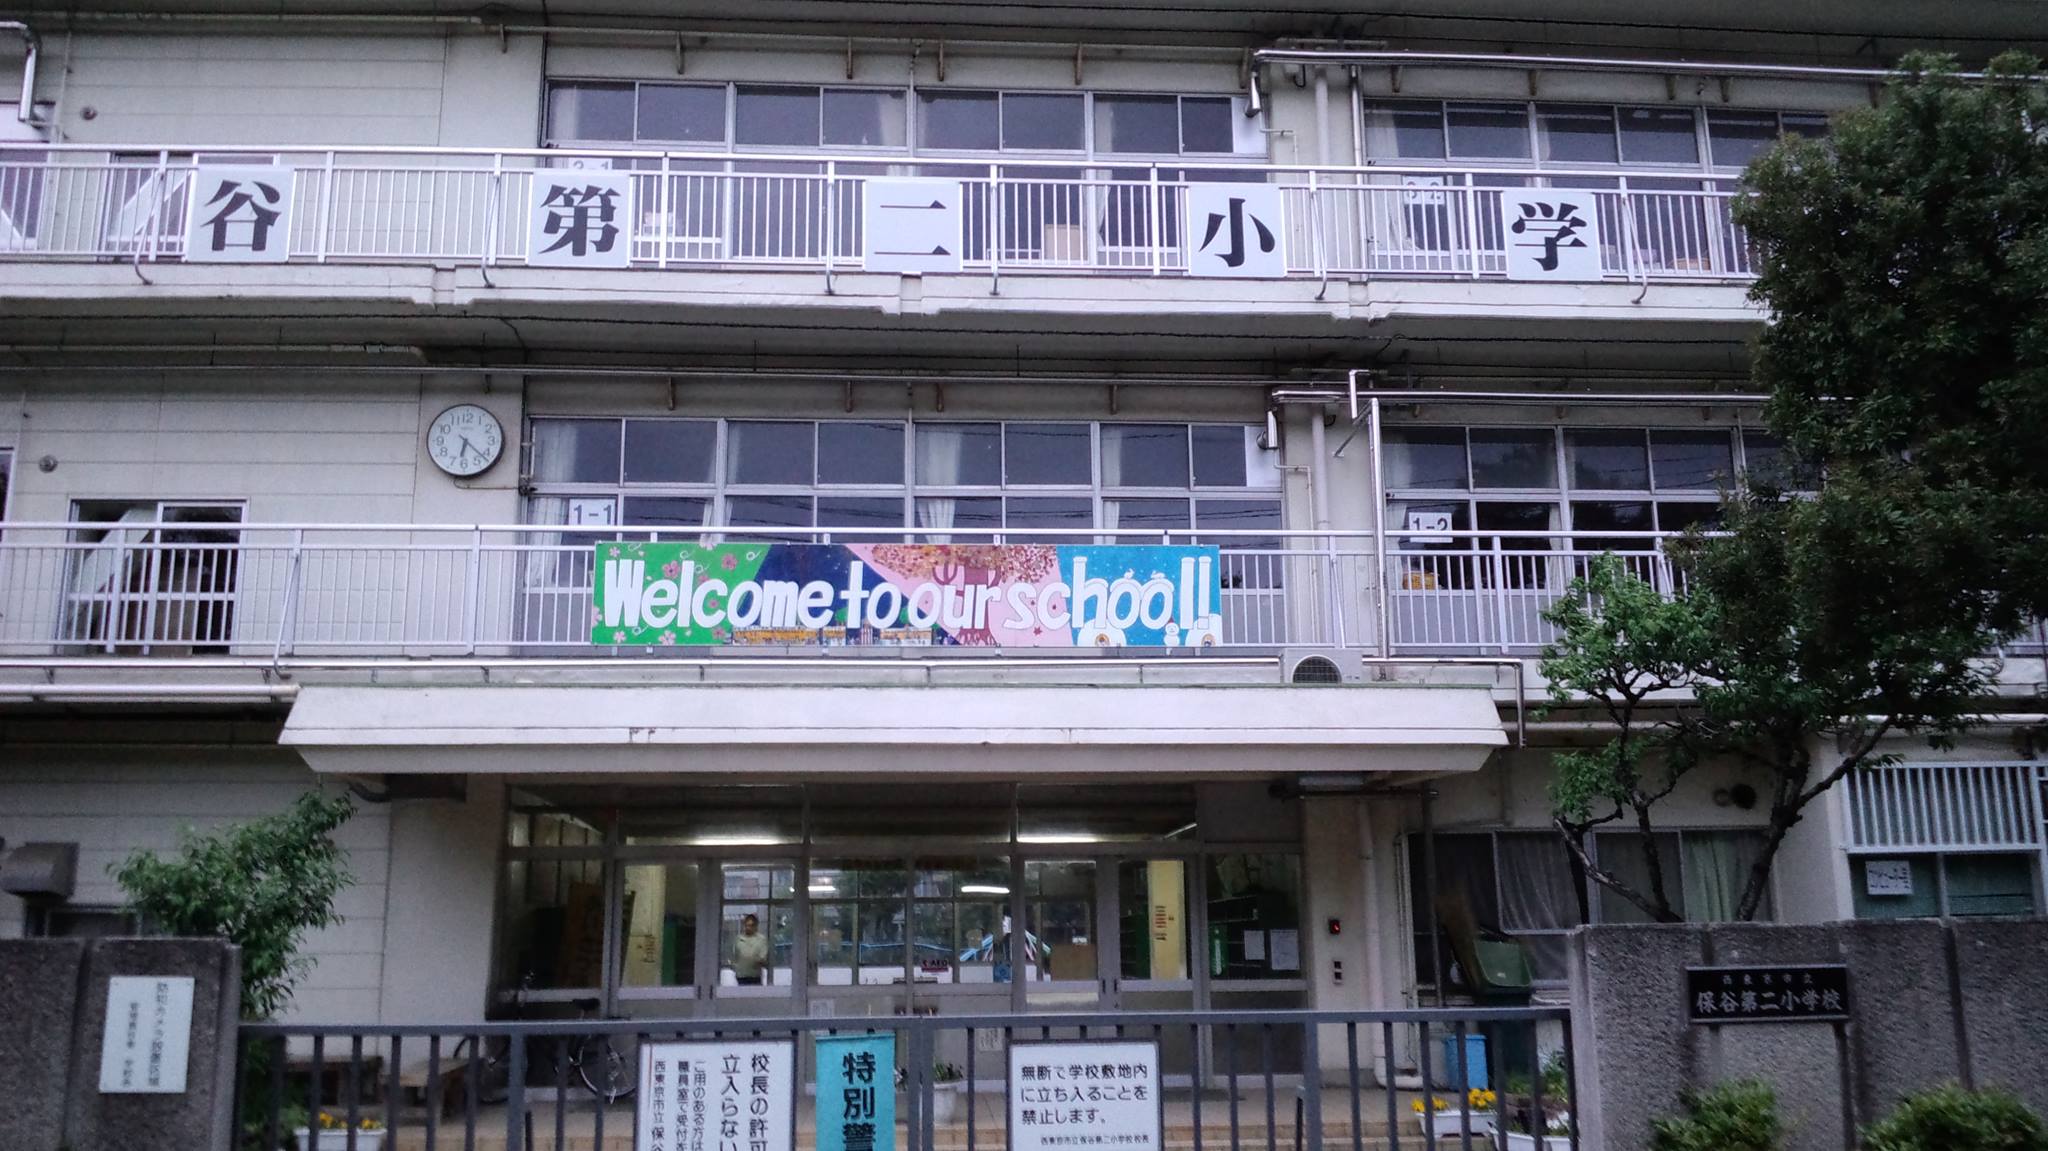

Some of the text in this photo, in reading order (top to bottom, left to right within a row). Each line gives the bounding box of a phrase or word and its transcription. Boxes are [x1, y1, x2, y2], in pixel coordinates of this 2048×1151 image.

[201, 179, 1588, 271] 谷 第 二 小 学
[573, 504, 612, 524] 1-1
[604, 559, 835, 628] Welcome
[840, 560, 901, 629] to
[908, 582, 1000, 629] our
[1696, 989, 1843, 1013] 保谷第二小学校
[1021, 1063, 1148, 1081] 無断で学校敷地内
[1021, 1086, 1148, 1103] に立ち入ることを
[720, 1054, 742, 1151] 立入らない
[750, 1053, 770, 1151] 校長の許可
[842, 1051, 876, 1151] 特別警
[1022, 1108, 1106, 1125] 禁止します。
